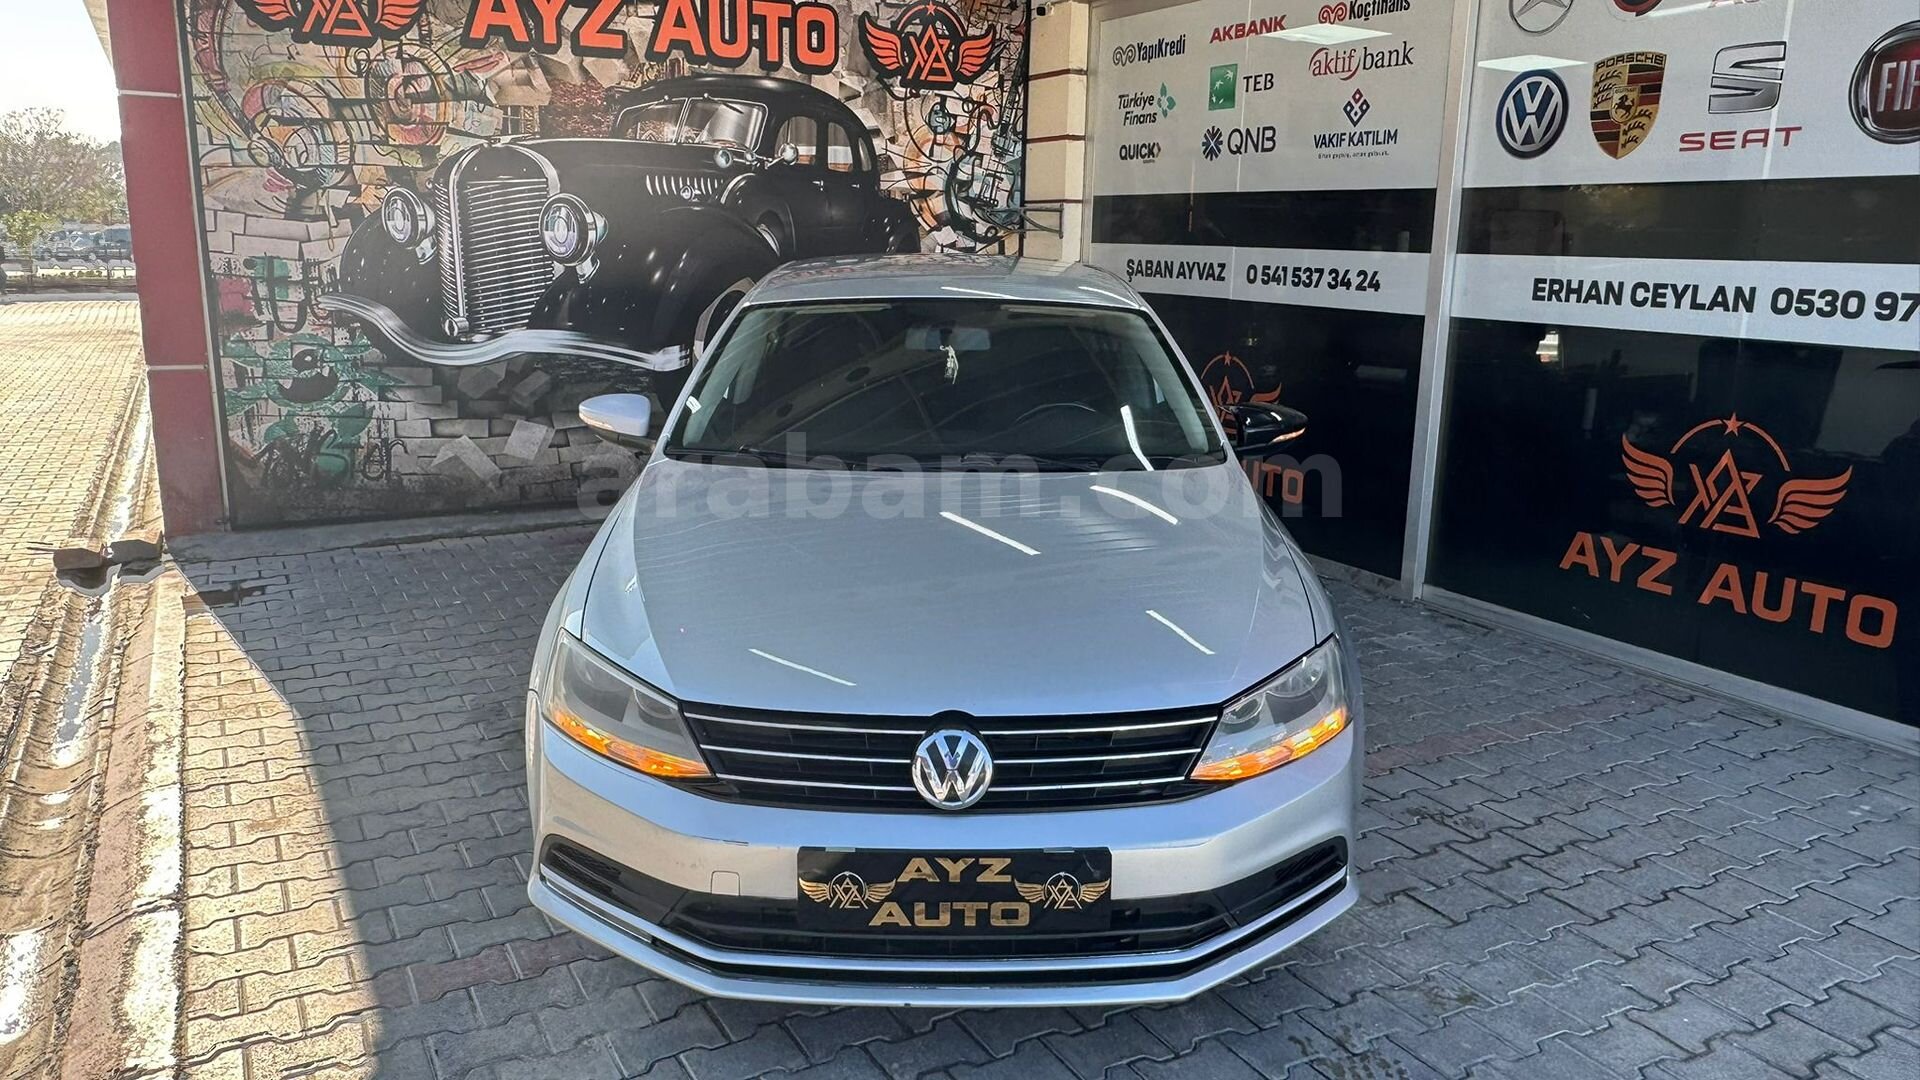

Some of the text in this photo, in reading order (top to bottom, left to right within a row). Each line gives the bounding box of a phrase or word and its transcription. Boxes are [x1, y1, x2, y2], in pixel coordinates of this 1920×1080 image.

[468, 0, 837, 67] AYZ AUTO
[1210, 14, 1287, 44] AKBANK
[1362, 41, 1414, 71] bank
[1595, 53, 1664, 72] PORSCHE
[1243, 73, 1274, 94] TEB
[1118, 91, 1155, 111] Türkiye
[1123, 110, 1157, 126] Finans
[1119, 142, 1155, 161] QUICK
[1227, 126, 1277, 155] QNB
[1313, 128, 1398, 149] VAKIF KATILIM
[1679, 127, 1802, 152] SEAT
[1126, 258, 1174, 282] ŞABAN
[1176, 262, 1226, 282] AYVAZ
[1291, 267, 1325, 289] 537
[1327, 268, 1352, 290] 34
[1355, 270, 1381, 292] 24
[1531, 278, 1625, 306] ERHAN
[1630, 282, 1757, 313] CEYLAN
[1770, 287, 1866, 319] 0530
[1242, 459, 1305, 504] UTO
[1559, 531, 1898, 649] AYZ AUTO
[896, 857, 1013, 883] AYZ
[868, 901, 1031, 927] AUTO
